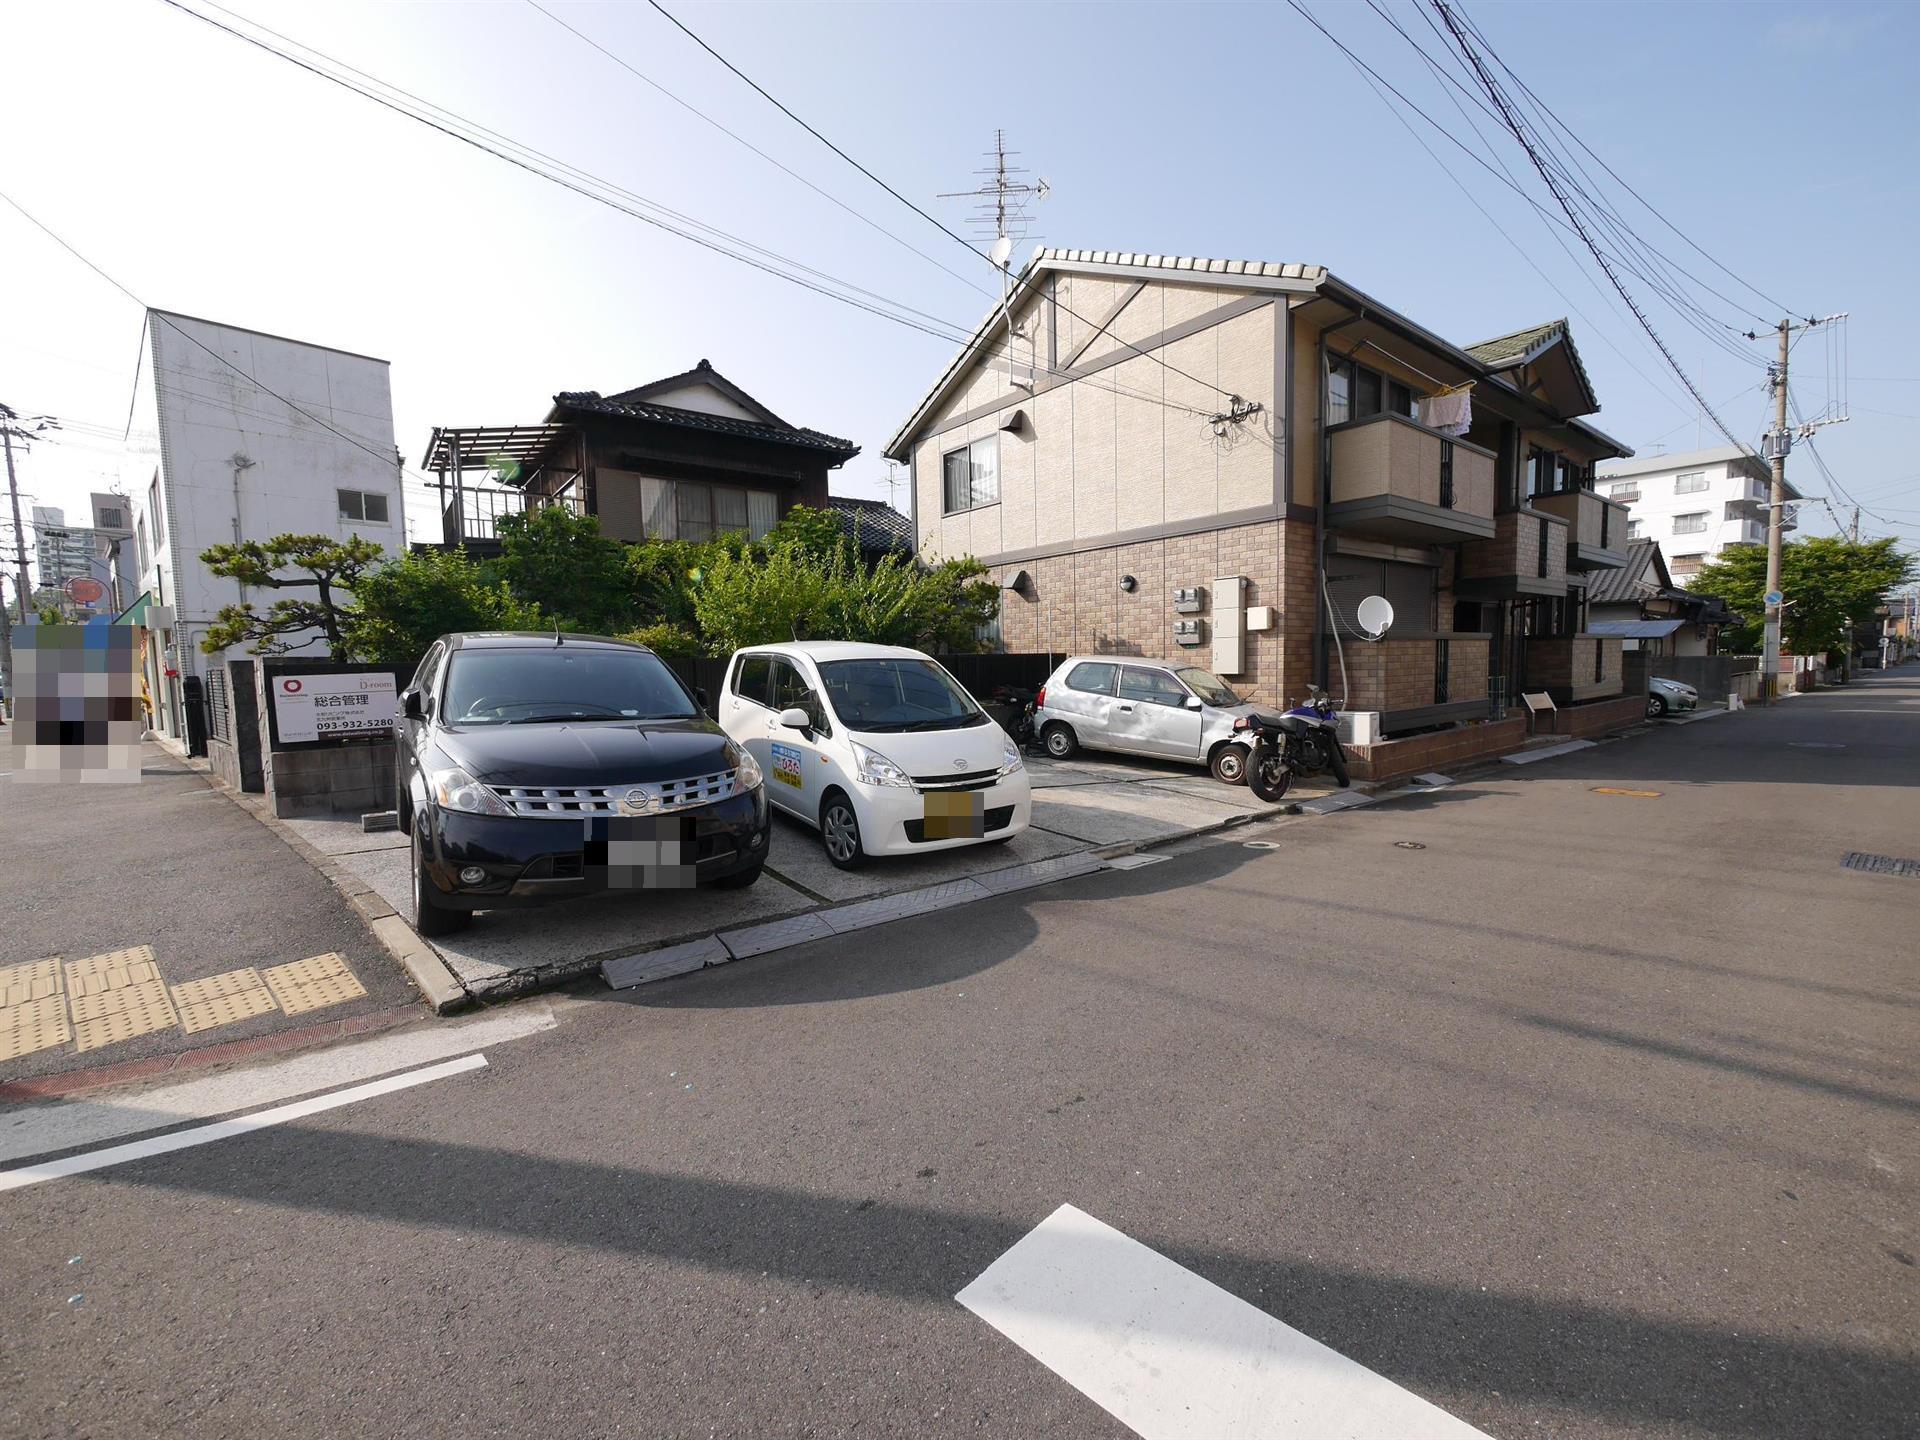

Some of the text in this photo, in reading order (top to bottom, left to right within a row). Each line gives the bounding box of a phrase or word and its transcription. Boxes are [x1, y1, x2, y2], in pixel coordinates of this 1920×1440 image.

[360, 681, 392, 689] D-room
[314, 694, 369, 707] 総合管理
[316, 718, 394, 730] 093-932-5280
